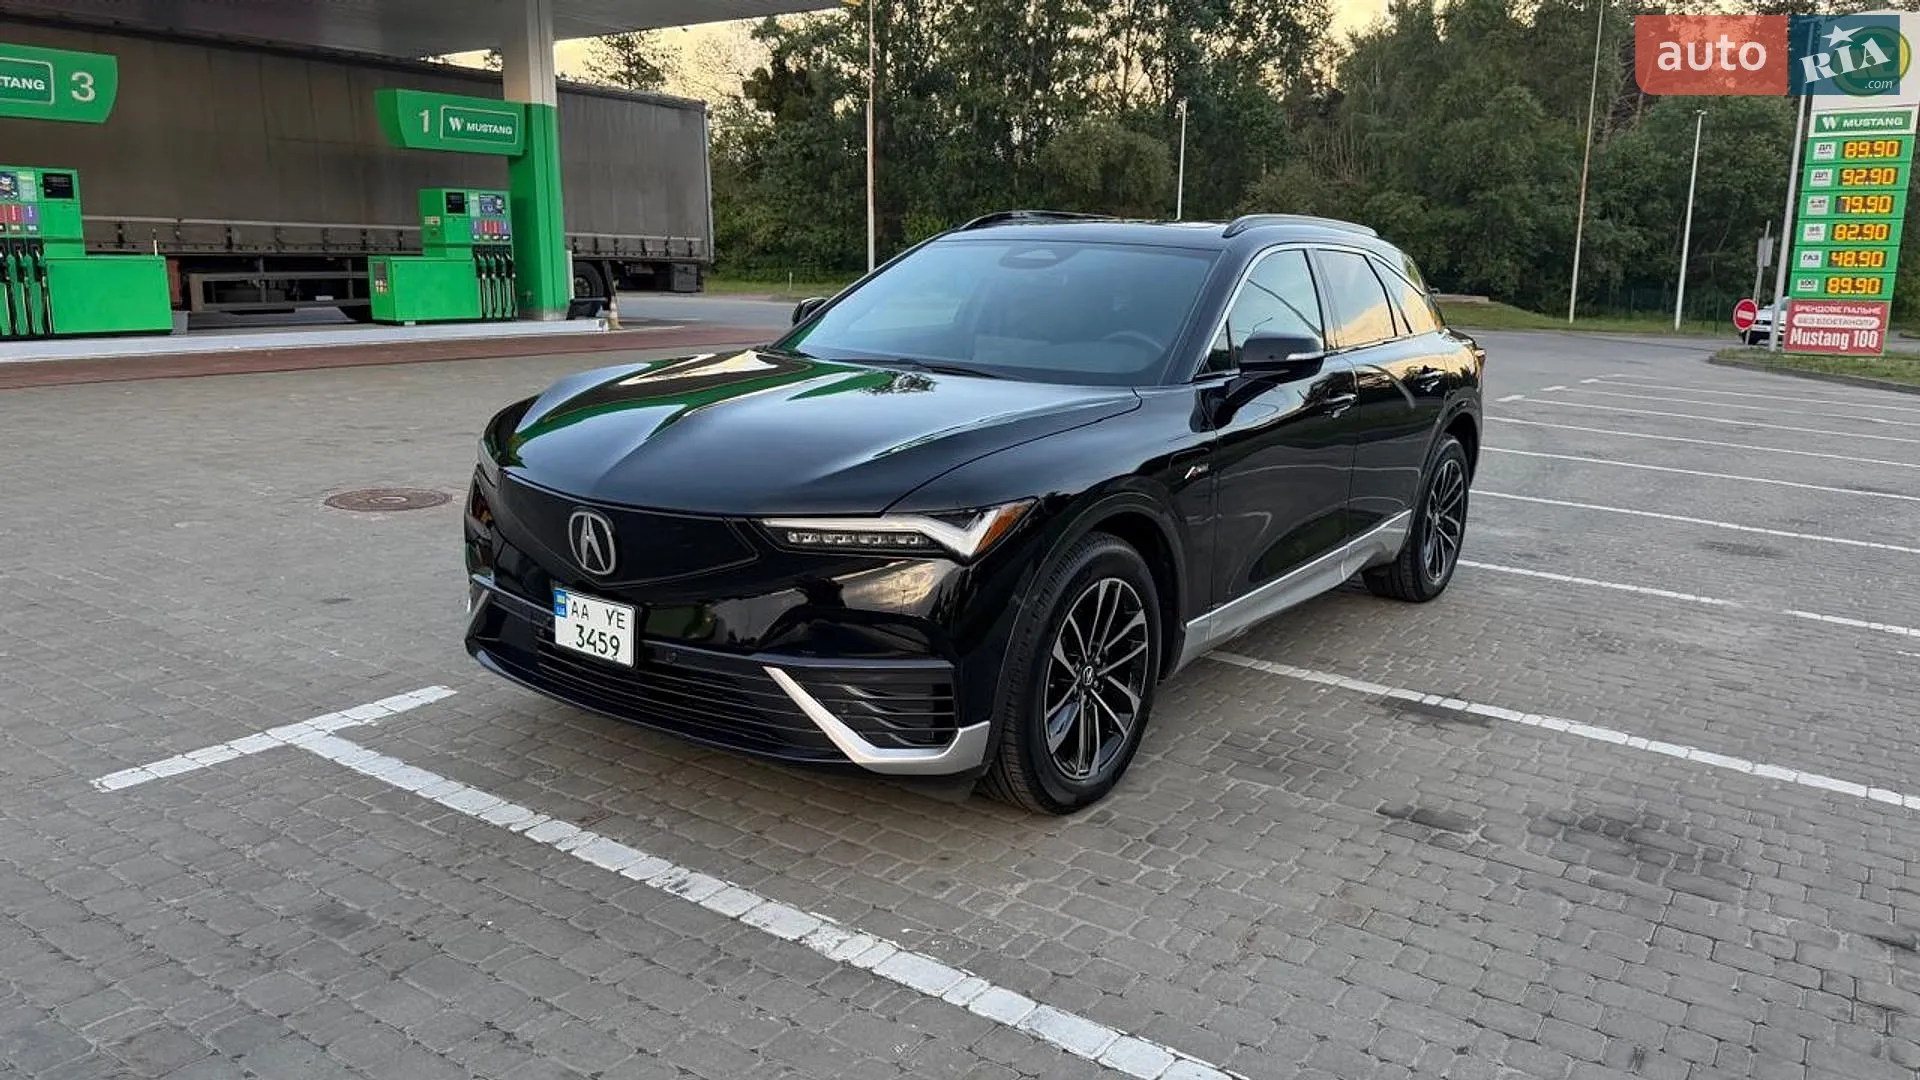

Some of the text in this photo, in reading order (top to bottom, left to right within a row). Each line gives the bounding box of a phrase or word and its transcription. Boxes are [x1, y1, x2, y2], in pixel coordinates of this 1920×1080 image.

[0, 76, 45, 90] TANG
[71, 71, 96, 102] 3
[418, 109, 430, 133] 1
[466, 122, 513, 135] MUSTANG
[1842, 117, 1904, 128] MUSTANG
[1844, 141, 1900, 159] 89.90
[1841, 168, 1896, 186] 92.90
[1840, 195, 1893, 213] 79.90
[1834, 223, 1888, 241] 82.90
[1831, 251, 1885, 267] 48.90
[1827, 277, 1881, 294] 89.90
[1789, 328, 1878, 351] Mustang 100
[571, 600, 626, 630] AA YE
[575, 623, 620, 657] 3459
